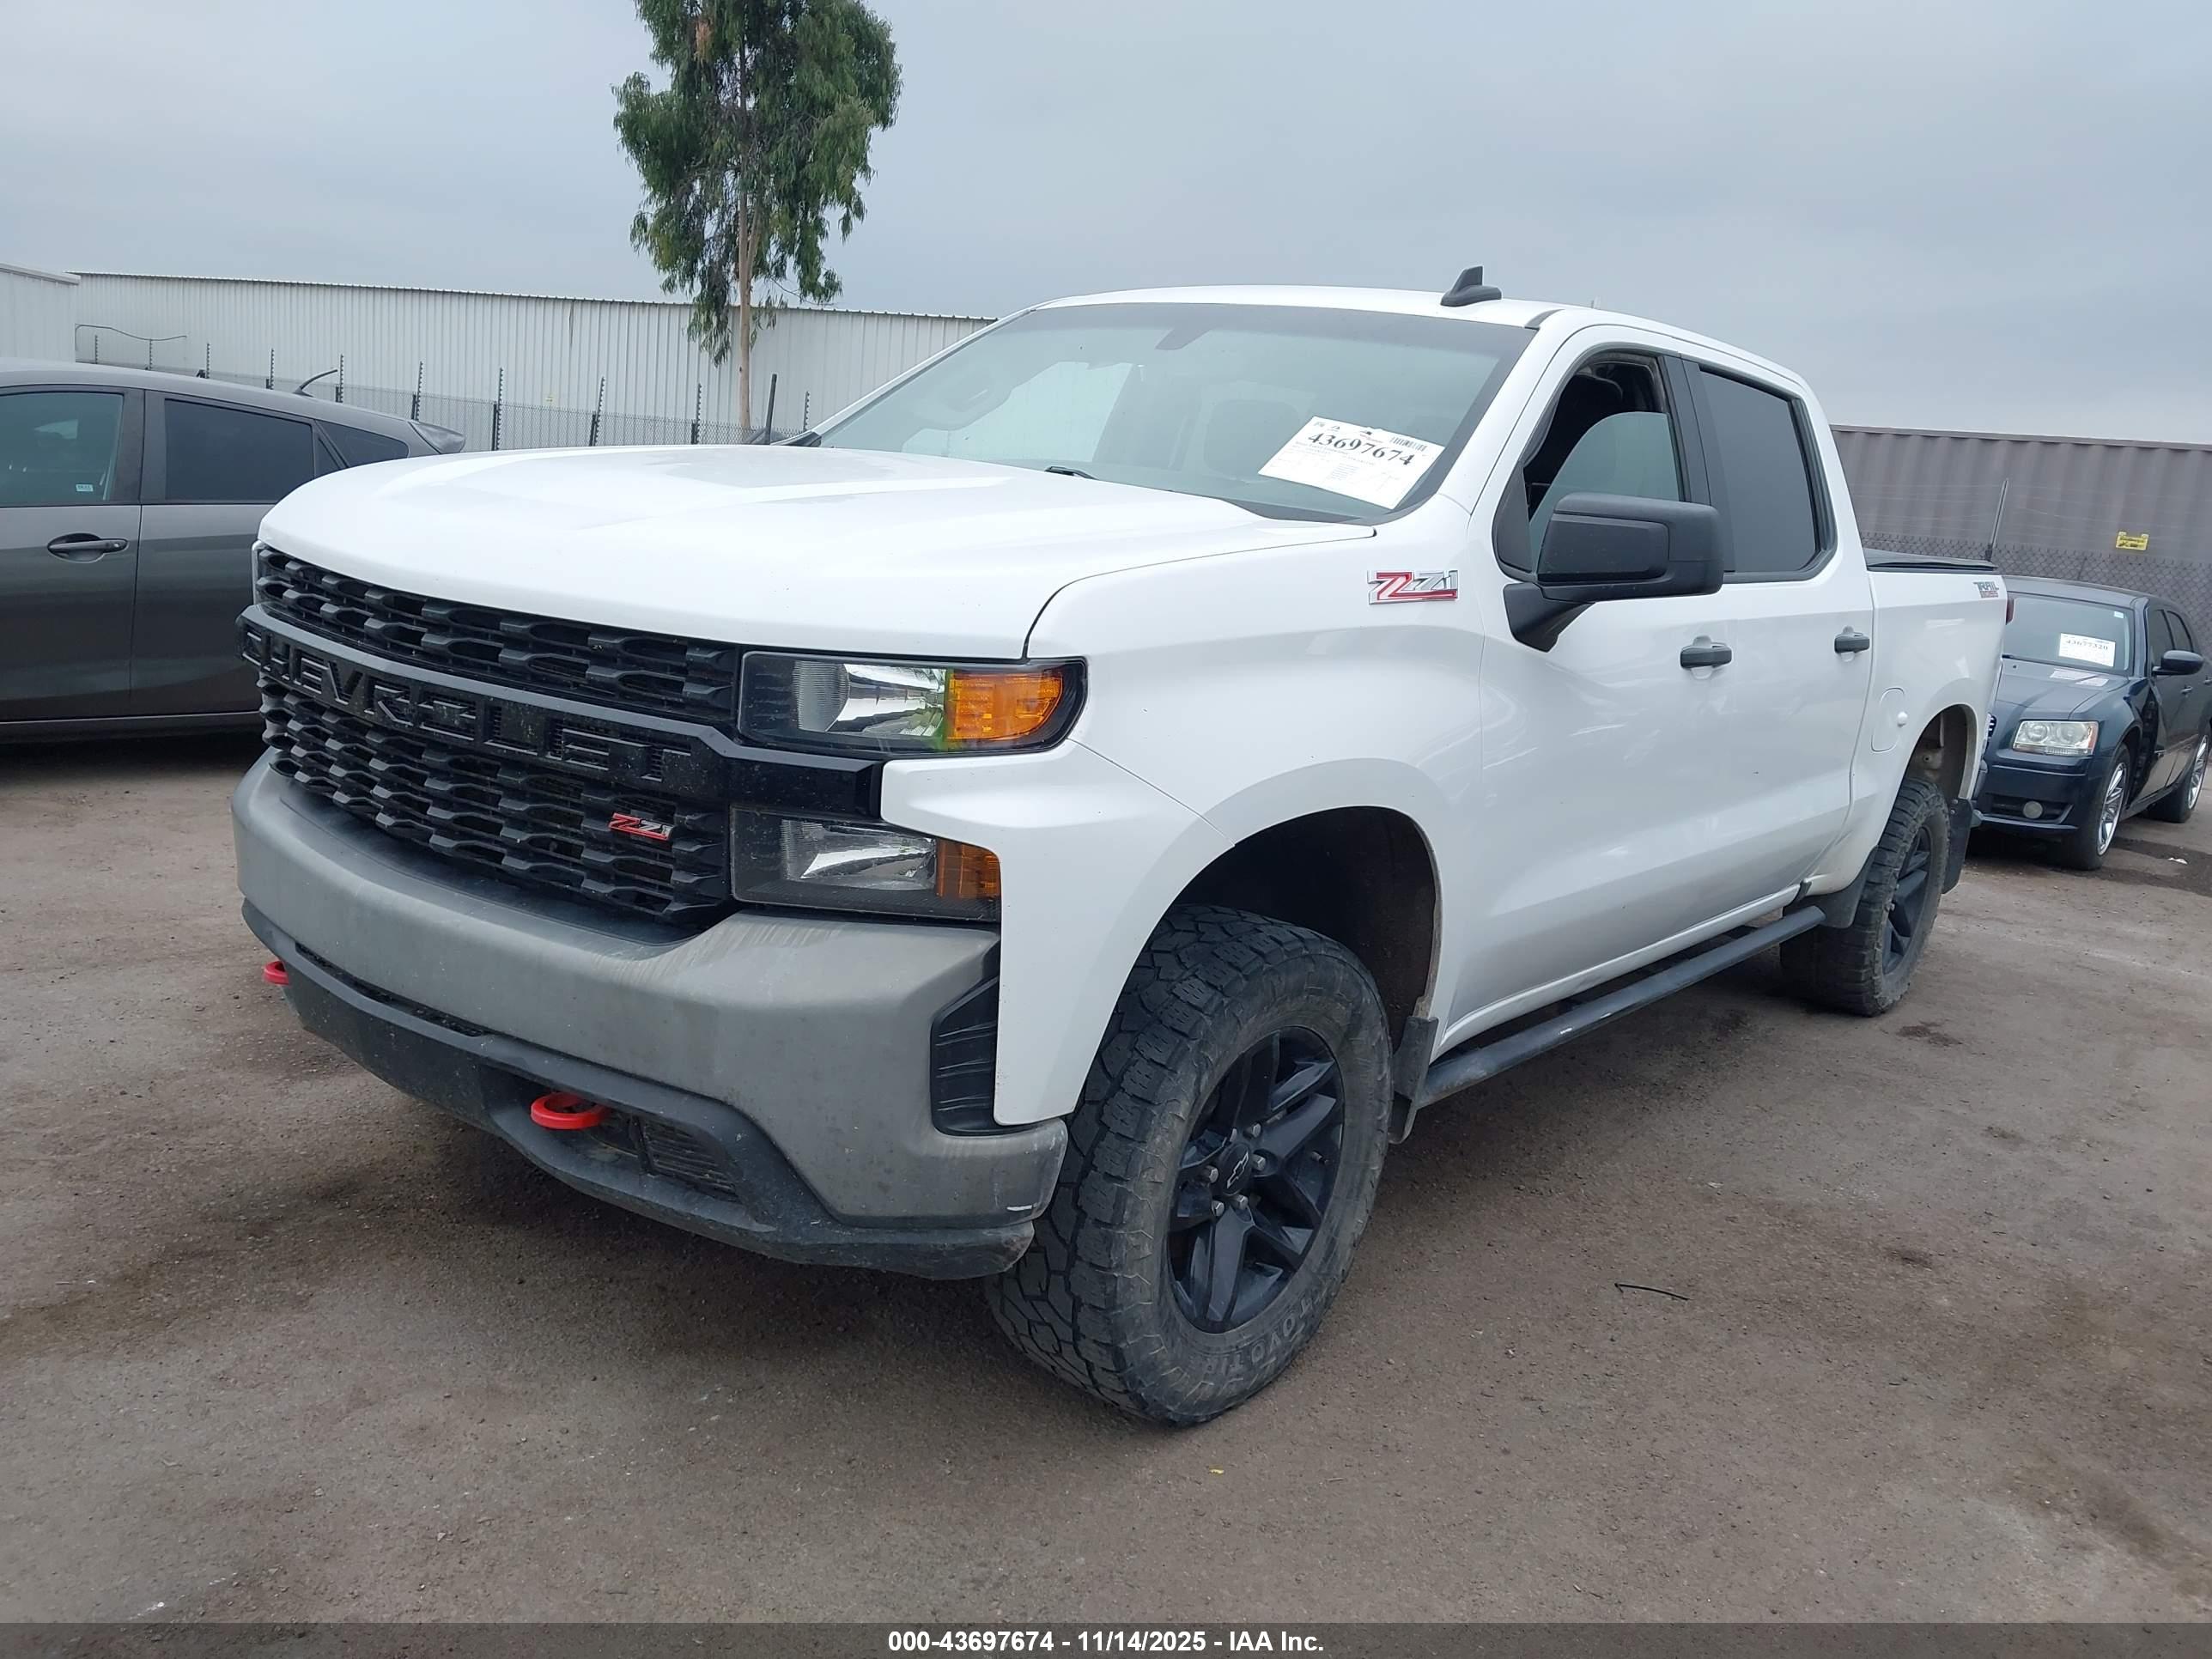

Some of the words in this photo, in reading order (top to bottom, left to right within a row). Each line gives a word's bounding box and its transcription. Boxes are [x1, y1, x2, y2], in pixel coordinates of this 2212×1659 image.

[1307, 431, 1415, 466] 43697674
[1367, 568, 1459, 605] Z71
[1972, 580, 2000, 591] TRAIL
[241, 625, 692, 782] CHEVROLET
[607, 811, 675, 842] Z71
